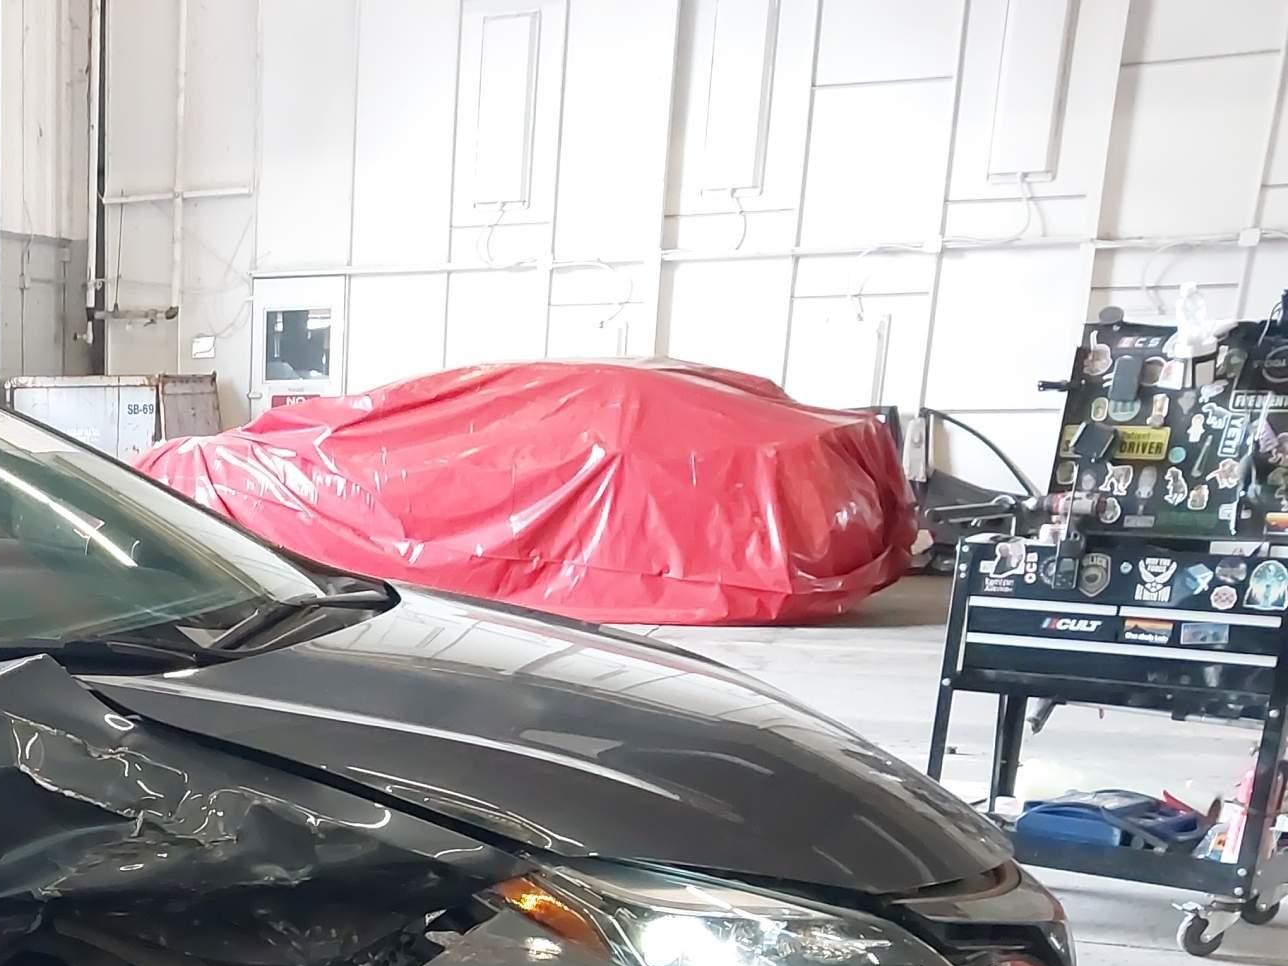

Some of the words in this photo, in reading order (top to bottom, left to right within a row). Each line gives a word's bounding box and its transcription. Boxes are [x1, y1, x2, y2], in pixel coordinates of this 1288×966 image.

[127, 403, 154, 415] SB-69
[1222, 417, 1244, 453] YETI
[1119, 441, 1164, 454] DRIVER
